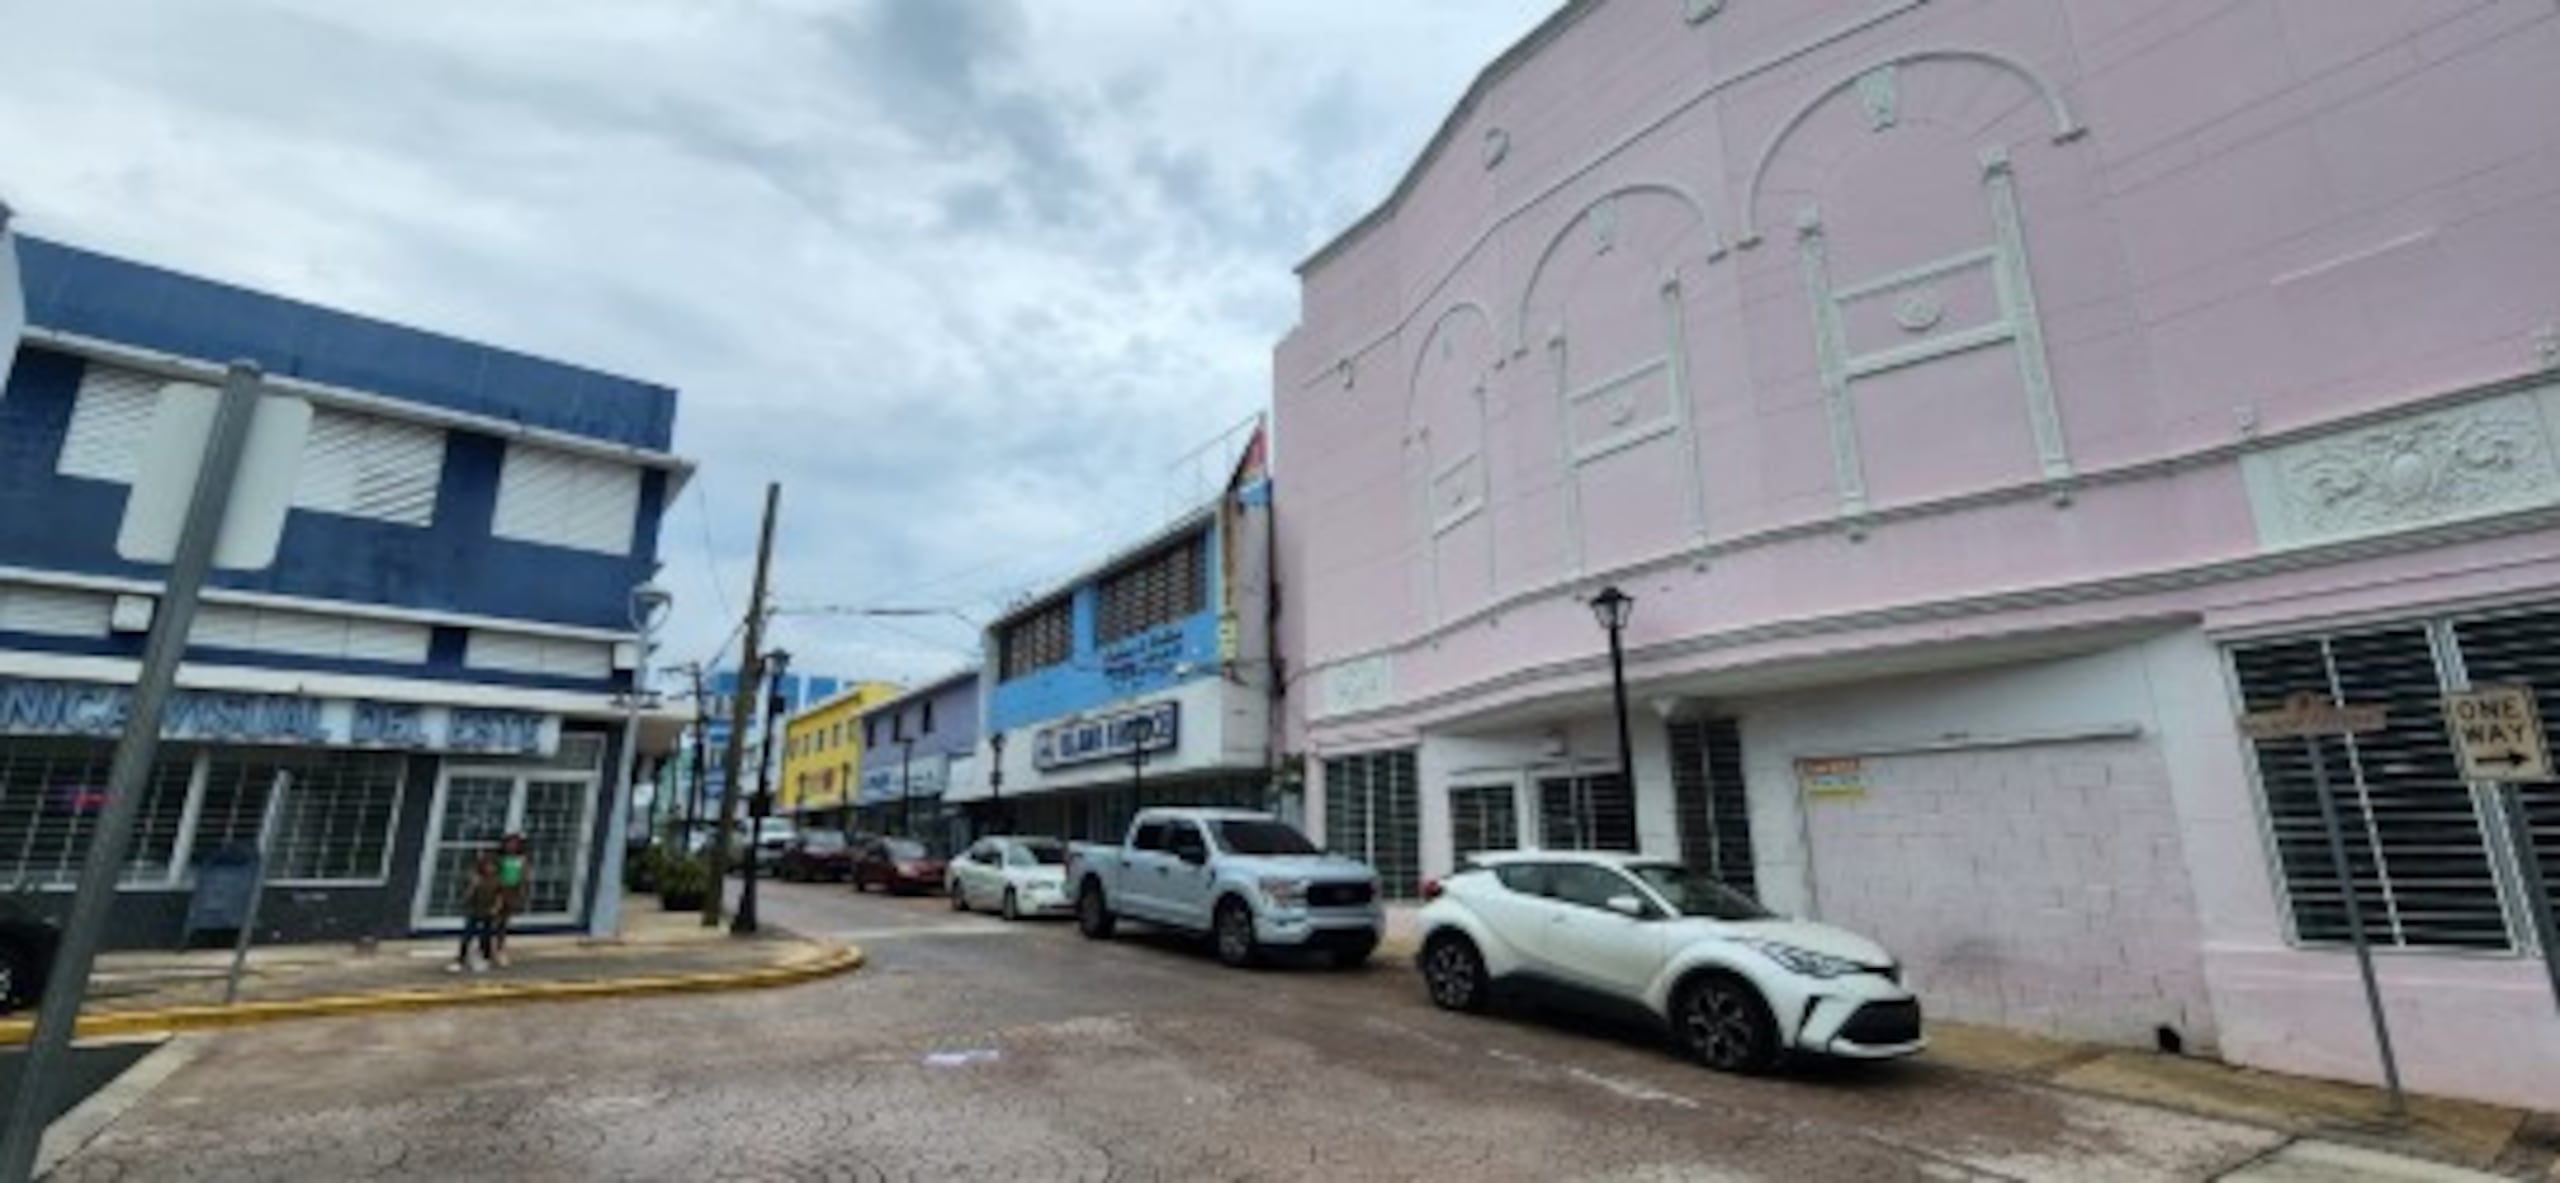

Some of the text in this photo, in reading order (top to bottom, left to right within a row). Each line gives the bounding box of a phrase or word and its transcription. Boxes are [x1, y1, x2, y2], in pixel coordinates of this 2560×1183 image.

[2456, 696, 2523, 719] ONE
[165, 692, 333, 743] VISUAL
[353, 701, 430, 748] DEL
[450, 709, 542, 756] ESTE
[2462, 723, 2524, 743] WAY
